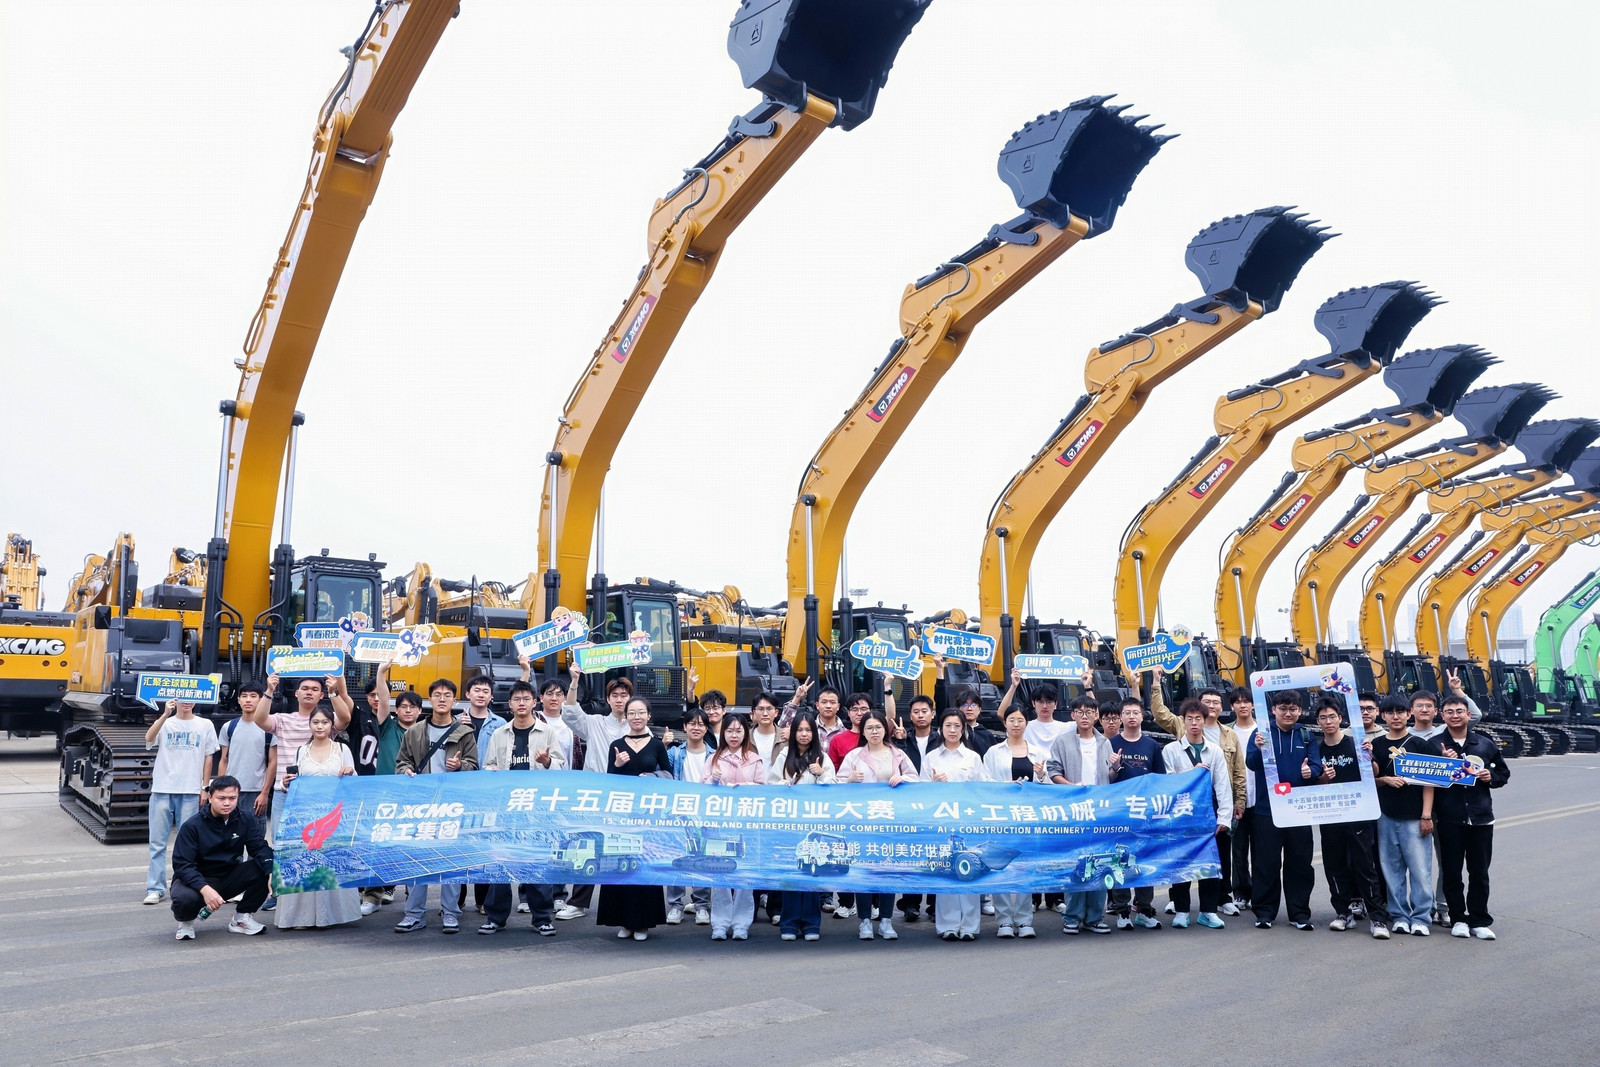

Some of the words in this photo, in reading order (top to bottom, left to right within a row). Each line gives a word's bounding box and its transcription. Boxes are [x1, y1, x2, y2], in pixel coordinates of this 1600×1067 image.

[629, 302, 650, 342] XCMG
[886, 372, 908, 405] XCMG
[1074, 425, 1096, 453] XCMG
[1206, 463, 1227, 487] XCMG
[1286, 498, 1306, 520] XCMG
[1360, 519, 1379, 539] XCMG
[1424, 536, 1441, 554] XCMG
[360, 638, 398, 650] 青春滚烫
[538, 630, 576, 652] 助您成功
[933, 635, 973, 646] 时代赛场
[858, 643, 888, 657] 敢创
[1126, 643, 1168, 660] 你的热爱
[1140, 650, 1182, 667] 自带光芒
[1024, 656, 1052, 667] 创新
[143, 676, 199, 689] 汇聚全球智慧
[157, 687, 213, 700] 点燃创新激情
[1397, 759, 1448, 770] 工程科技引领
[506, 787, 895, 820] 第十五届中国创新创业大赛
[1126, 792, 1194, 820] 专业赛
[1287, 792, 1362, 804] 第十五届中国创新创业大赛
[396, 802, 464, 819] XCMG
[371, 821, 460, 843] 徐工集团
[619, 818, 651, 826] CHINA
[655, 819, 718, 828] INNOVATION
[722, 821, 743, 829] AND
[746, 822, 846, 832] ENTREPRENEURSHIP
[850, 824, 917, 833] COMPETITION
[959, 826, 1031, 834] CONSTRUCTION
[1093, 825, 1130, 834] DIVISION
[866, 842, 953, 858] 共创美好世界
